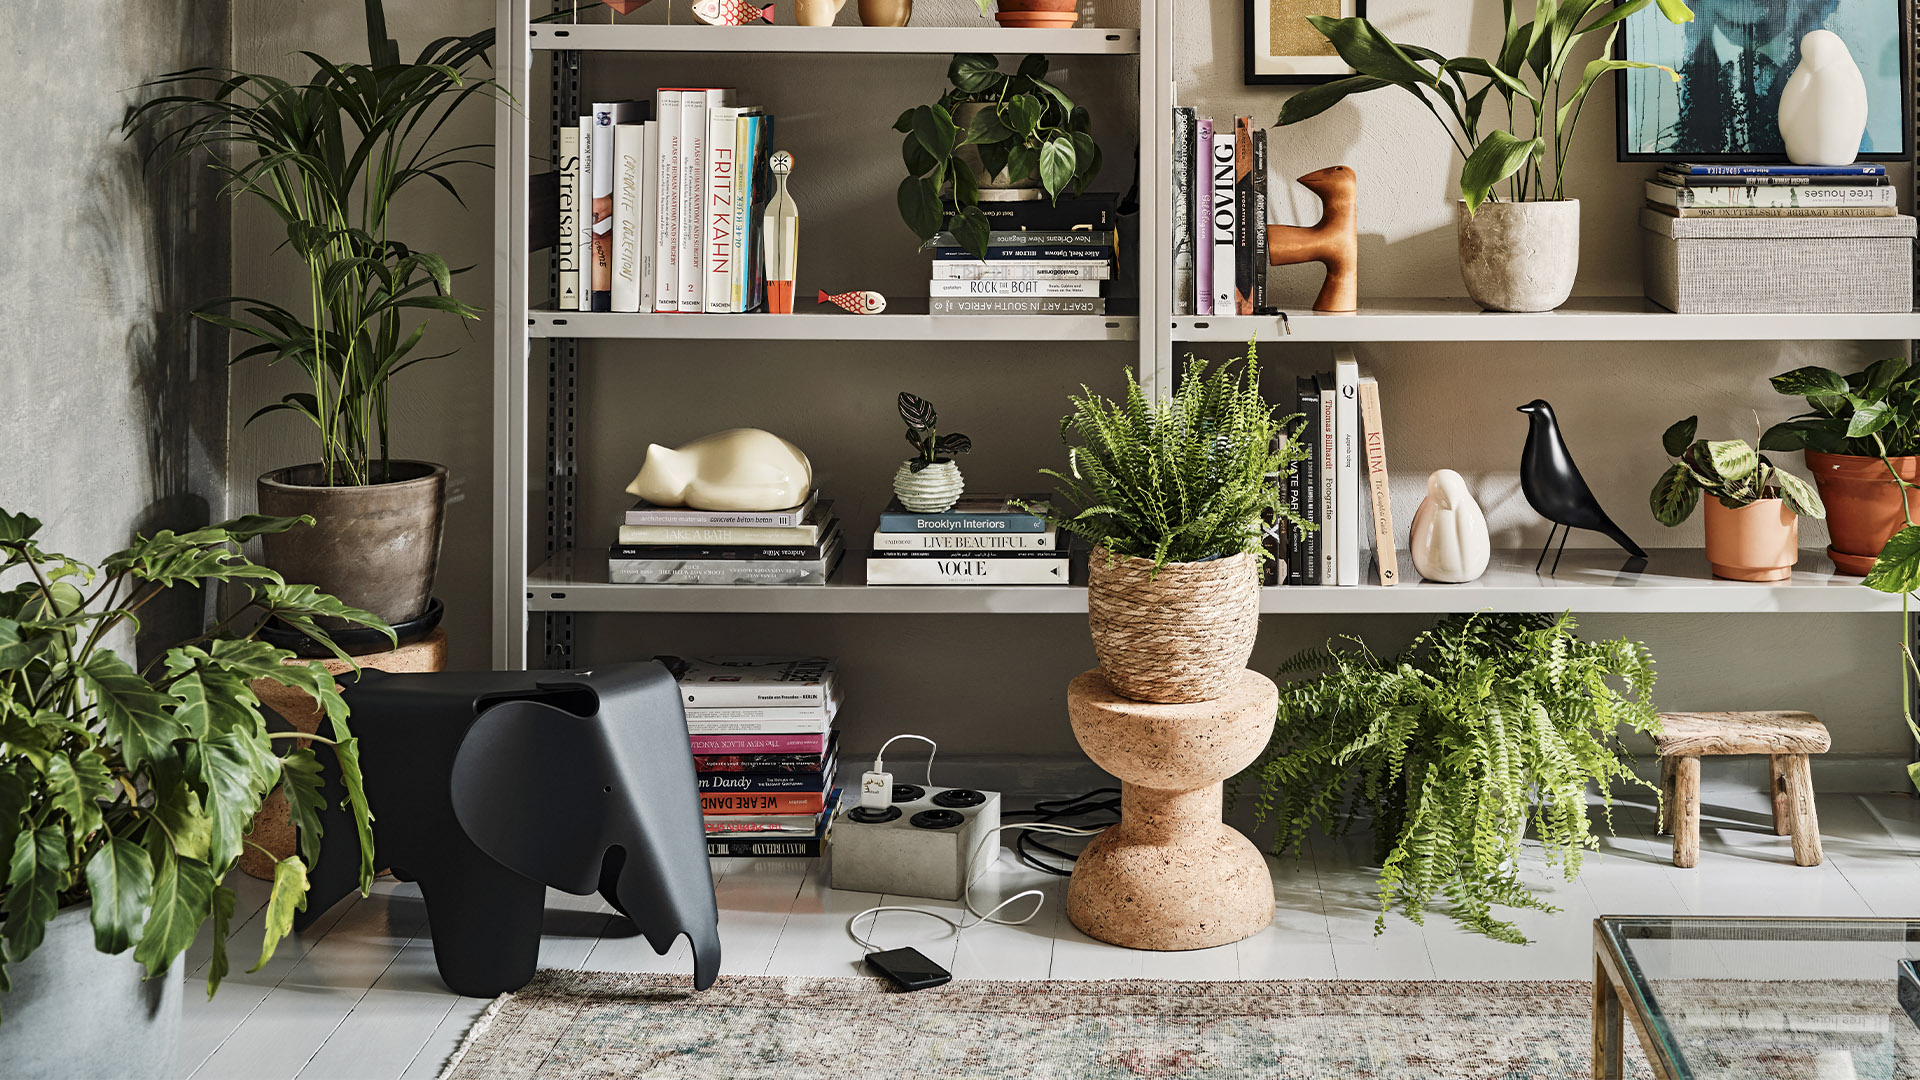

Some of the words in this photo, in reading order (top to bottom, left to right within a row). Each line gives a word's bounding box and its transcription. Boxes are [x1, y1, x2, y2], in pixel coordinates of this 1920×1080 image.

[671, 156, 677, 164] OF
[694, 158, 700, 166] OF
[1706, 167, 1740, 175] SÜDAFRIKA
[713, 148, 731, 206] FRITZ
[621, 154, 637, 216] CORPORATE
[1214, 143, 1234, 247] LOVING
[1804, 190, 1846, 203] houses
[1849, 189, 1873, 200] tree
[712, 214, 730, 273] KAHN
[997, 235, 1027, 244] Elegance
[666, 283, 670, 291] 1
[688, 284, 694, 292] 2
[970, 281, 998, 293] ROCK
[1011, 281, 1038, 293] BOAT
[958, 302, 992, 310] AFRICA
[994, 302, 1028, 310] SOUTH
[1030, 302, 1040, 310] IN
[1042, 302, 1060, 310] ART
[1063, 302, 1094, 310] CRAFT
[1342, 384, 1354, 399] Q
[1325, 400, 1333, 432] Thomas
[1325, 434, 1333, 470] Billhardt
[1368, 432, 1384, 474] KILIM
[1290, 445, 1298, 487] PIVATE
[1375, 480, 1383, 490] The
[1322, 478, 1333, 520] Fotografie
[1376, 491, 1386, 517] Complete
[917, 519, 961, 530] Brooklyn
[963, 519, 1005, 529] Interiors
[1380, 517, 1388, 535] Guide
[666, 529, 689, 540] TAKE
[694, 530, 701, 540] A
[703, 529, 732, 540] BATH
[1308, 531, 1313, 539] AN
[923, 537, 952, 548] LIVE
[955, 536, 1027, 548] BEAUTIFUL
[938, 561, 987, 576] VOGUE
[698, 780, 709, 788] m
[712, 776, 752, 790] Dandy
[700, 797, 732, 809] DAND
[736, 797, 758, 809] ARE
[761, 796, 777, 809] WE
[726, 822, 765, 832] STEPHEN
[707, 844, 718, 854] EY
[718, 844, 729, 854] THE
[752, 843, 787, 854] VREELAND
[786, 843, 806, 854] DIANA
